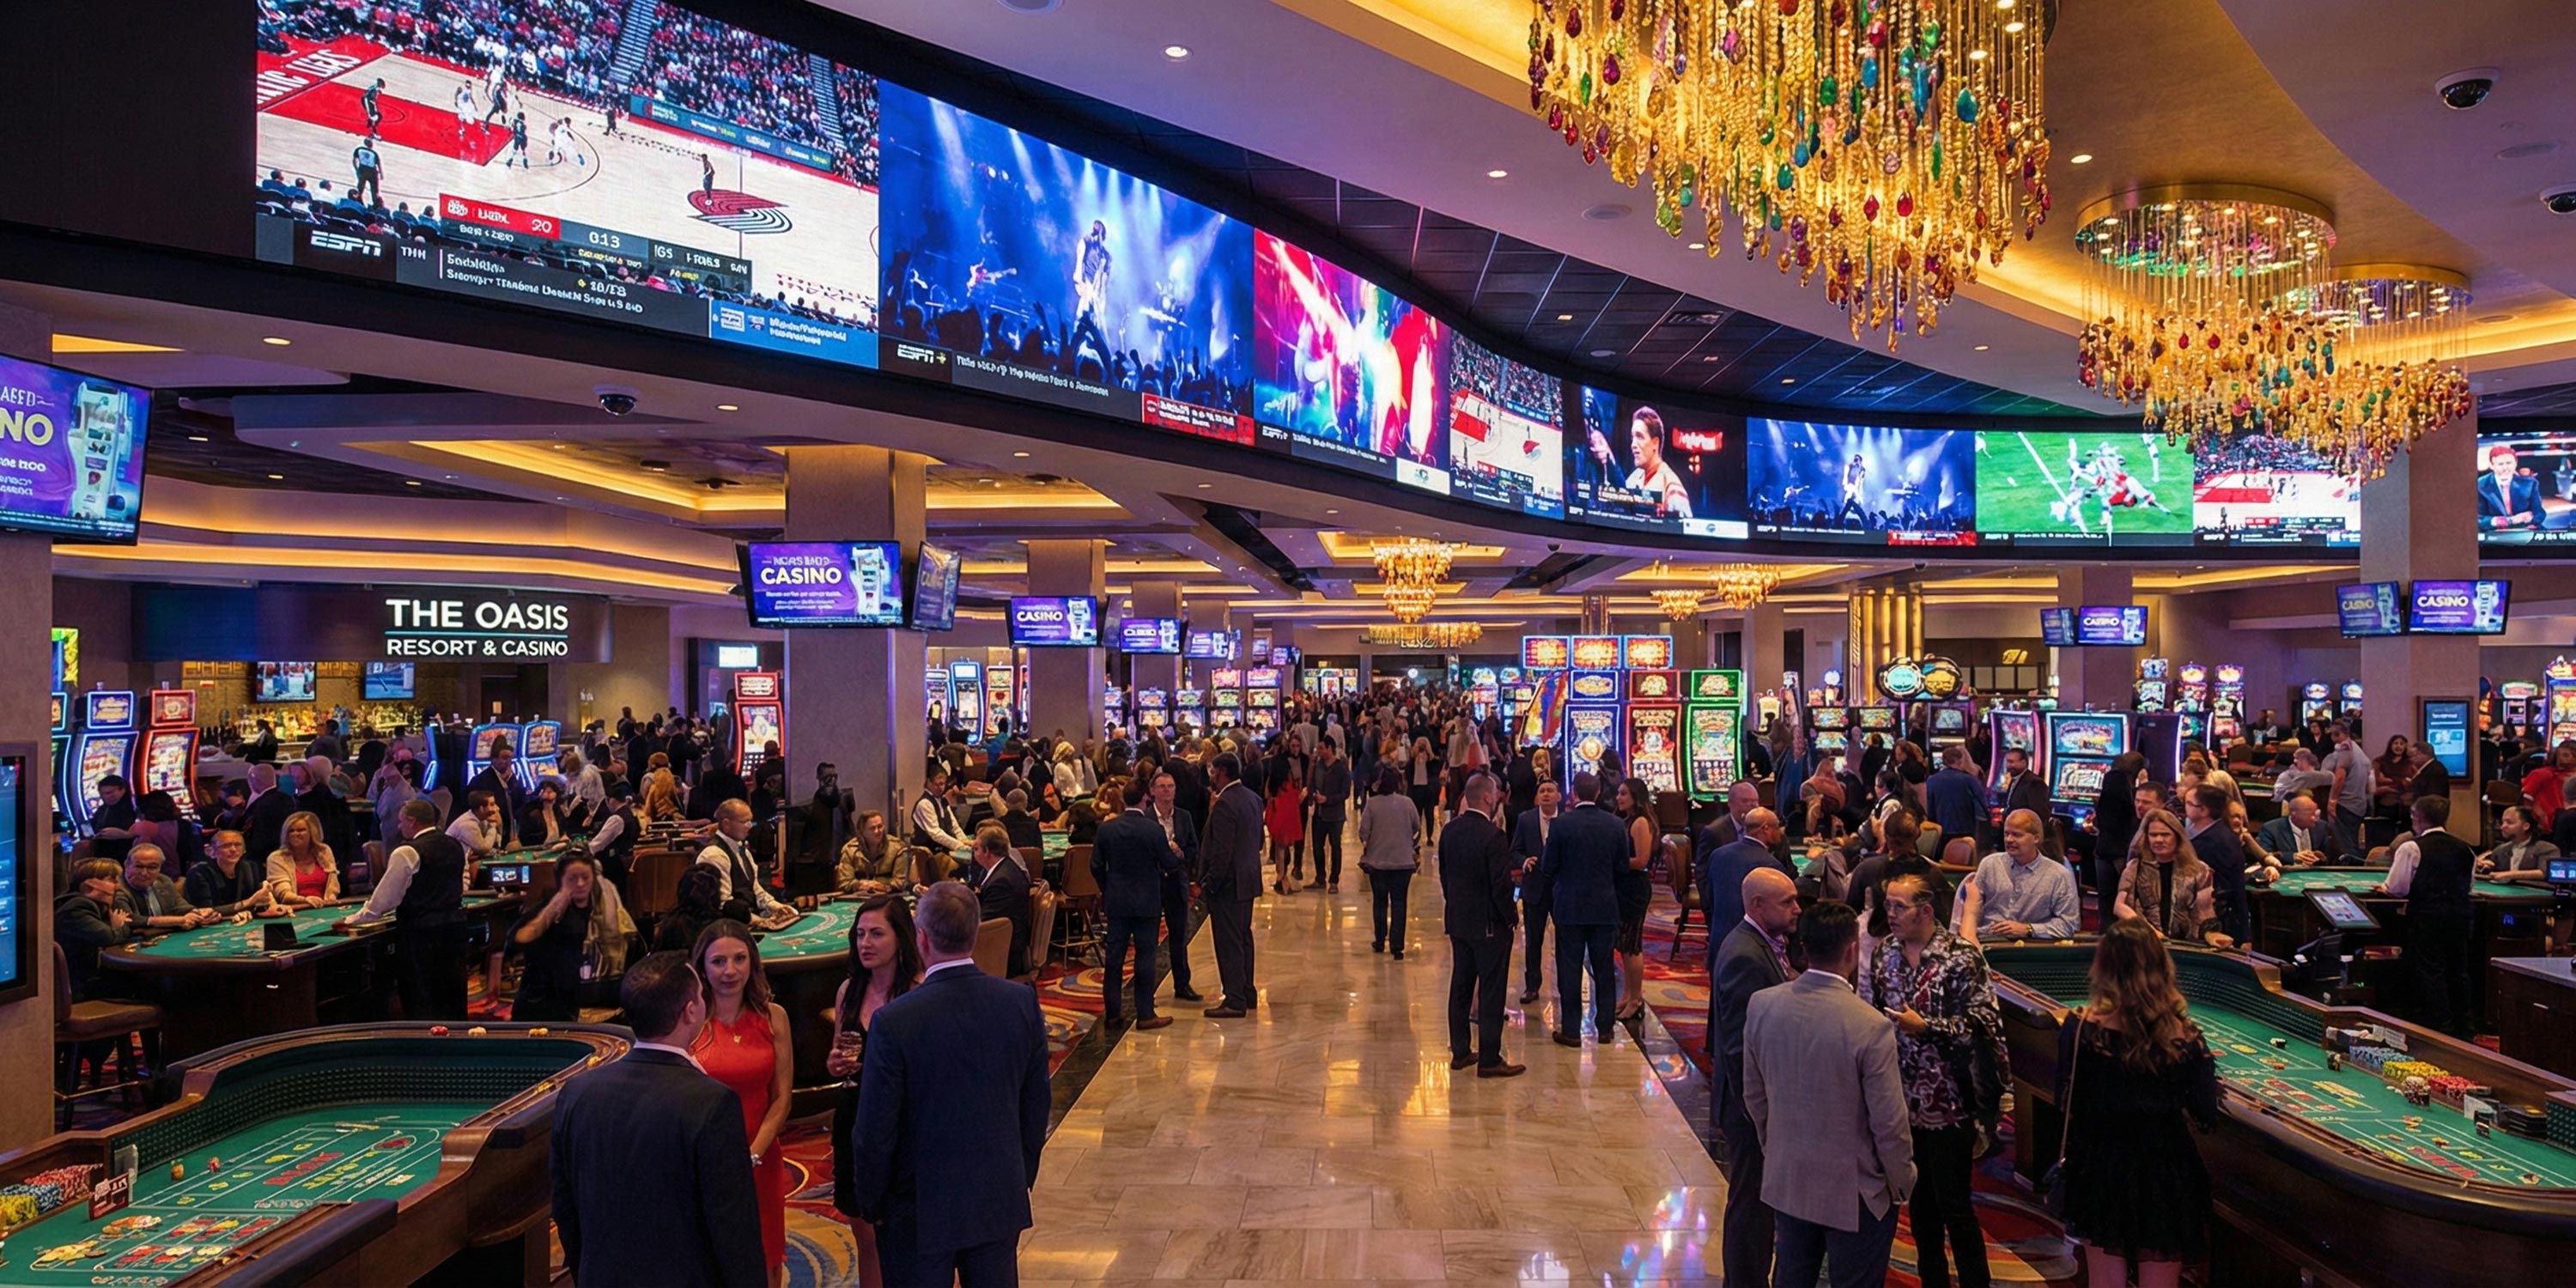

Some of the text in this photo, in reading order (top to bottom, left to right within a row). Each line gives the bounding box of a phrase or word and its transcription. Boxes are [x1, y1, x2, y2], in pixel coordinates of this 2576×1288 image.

[310, 230, 381, 257] ESPN
[760, 567, 842, 585] CASINO
[2417, 595, 2469, 607] CASINO
[386, 599, 568, 630] THE OASIS
[1017, 611, 1063, 622] CASINO
[387, 640, 568, 655] RESORT & CASINO
